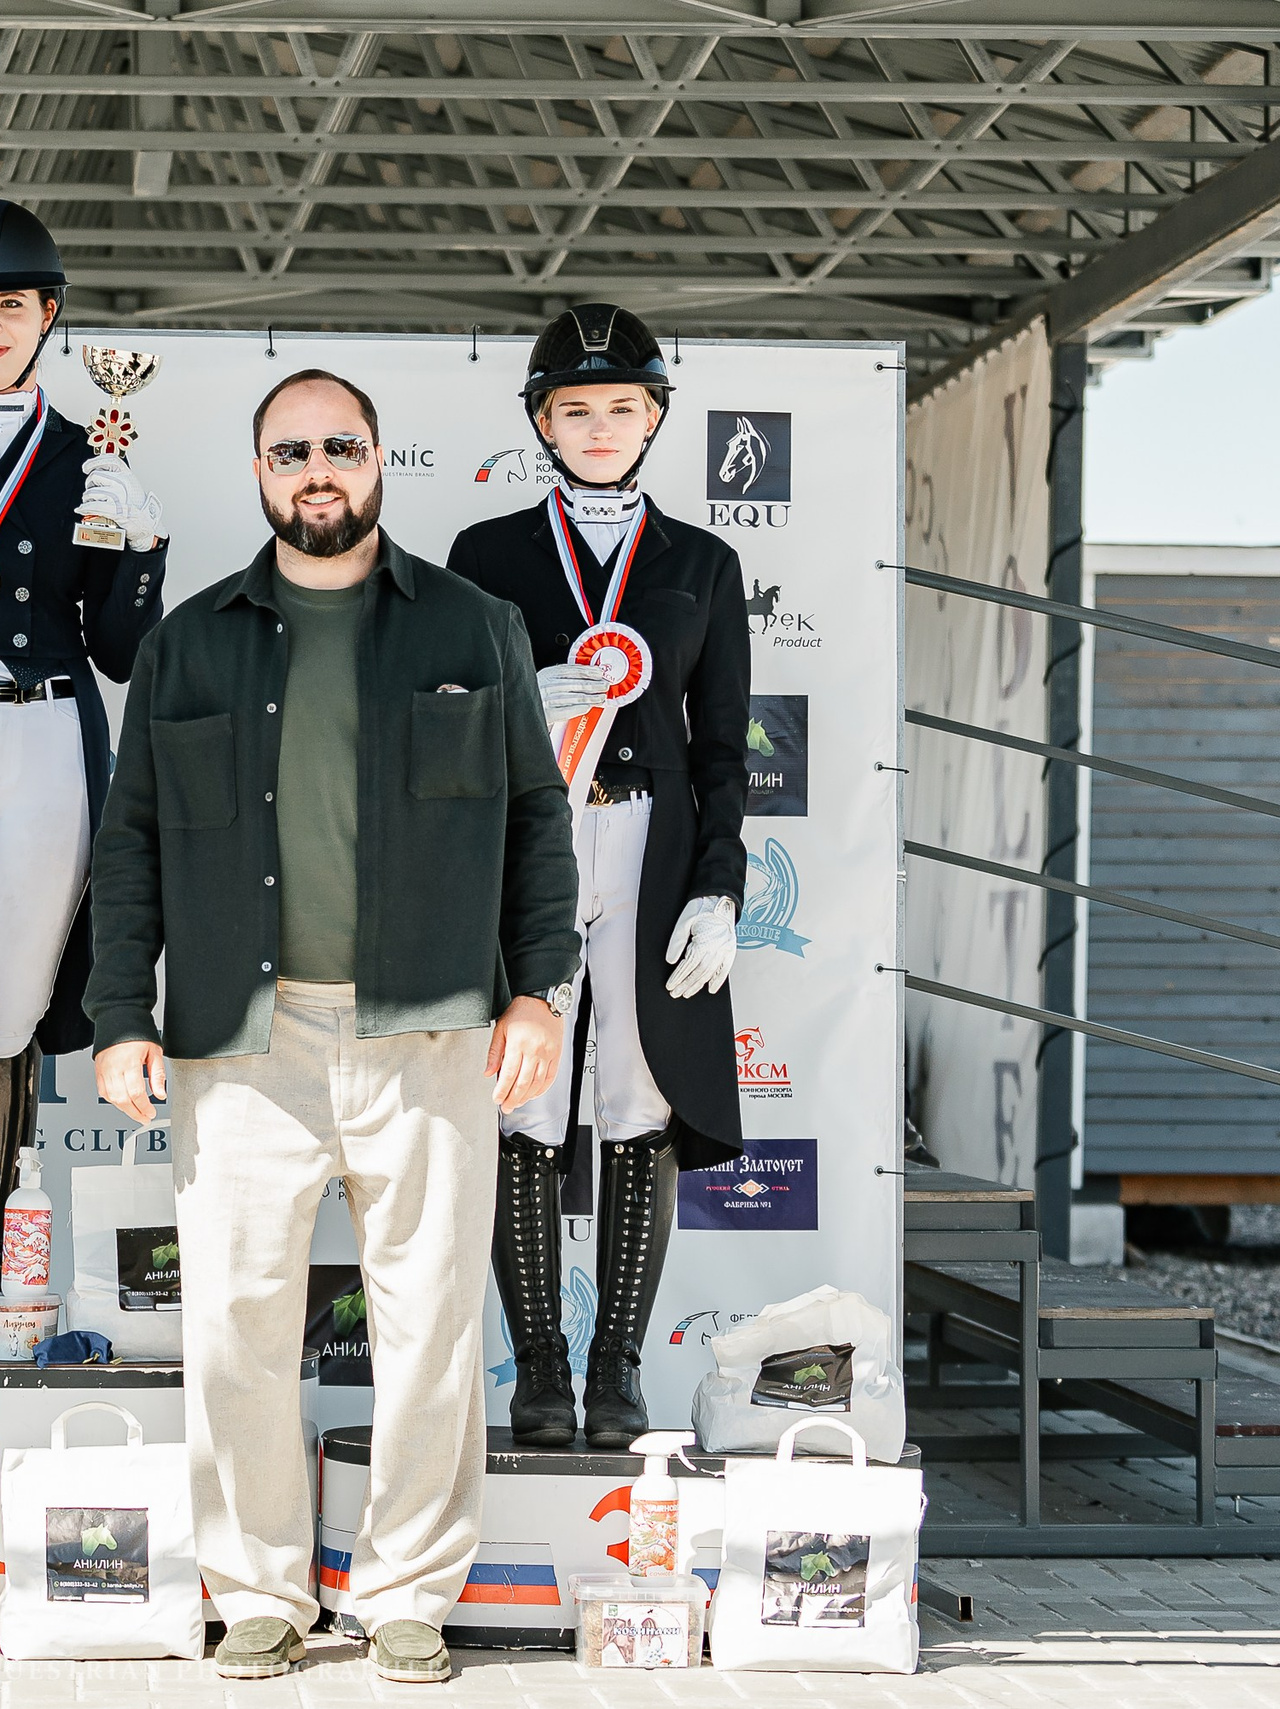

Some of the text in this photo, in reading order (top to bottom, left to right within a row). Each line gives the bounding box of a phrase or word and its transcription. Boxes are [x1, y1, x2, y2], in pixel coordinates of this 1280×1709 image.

[384, 443, 435, 468] NÍC
[706, 503, 792, 528] EQU
[773, 636, 823, 648] Product
[564, 754, 573, 769] ПО
[748, 772, 784, 788] ЛИН
[724, 1201, 759, 1209] ФАБРИКА
[144, 1270, 180, 1281] АНИЛ
[322, 1342, 370, 1357] АНИЛ
[73, 1558, 123, 1569] АНИЛИН
